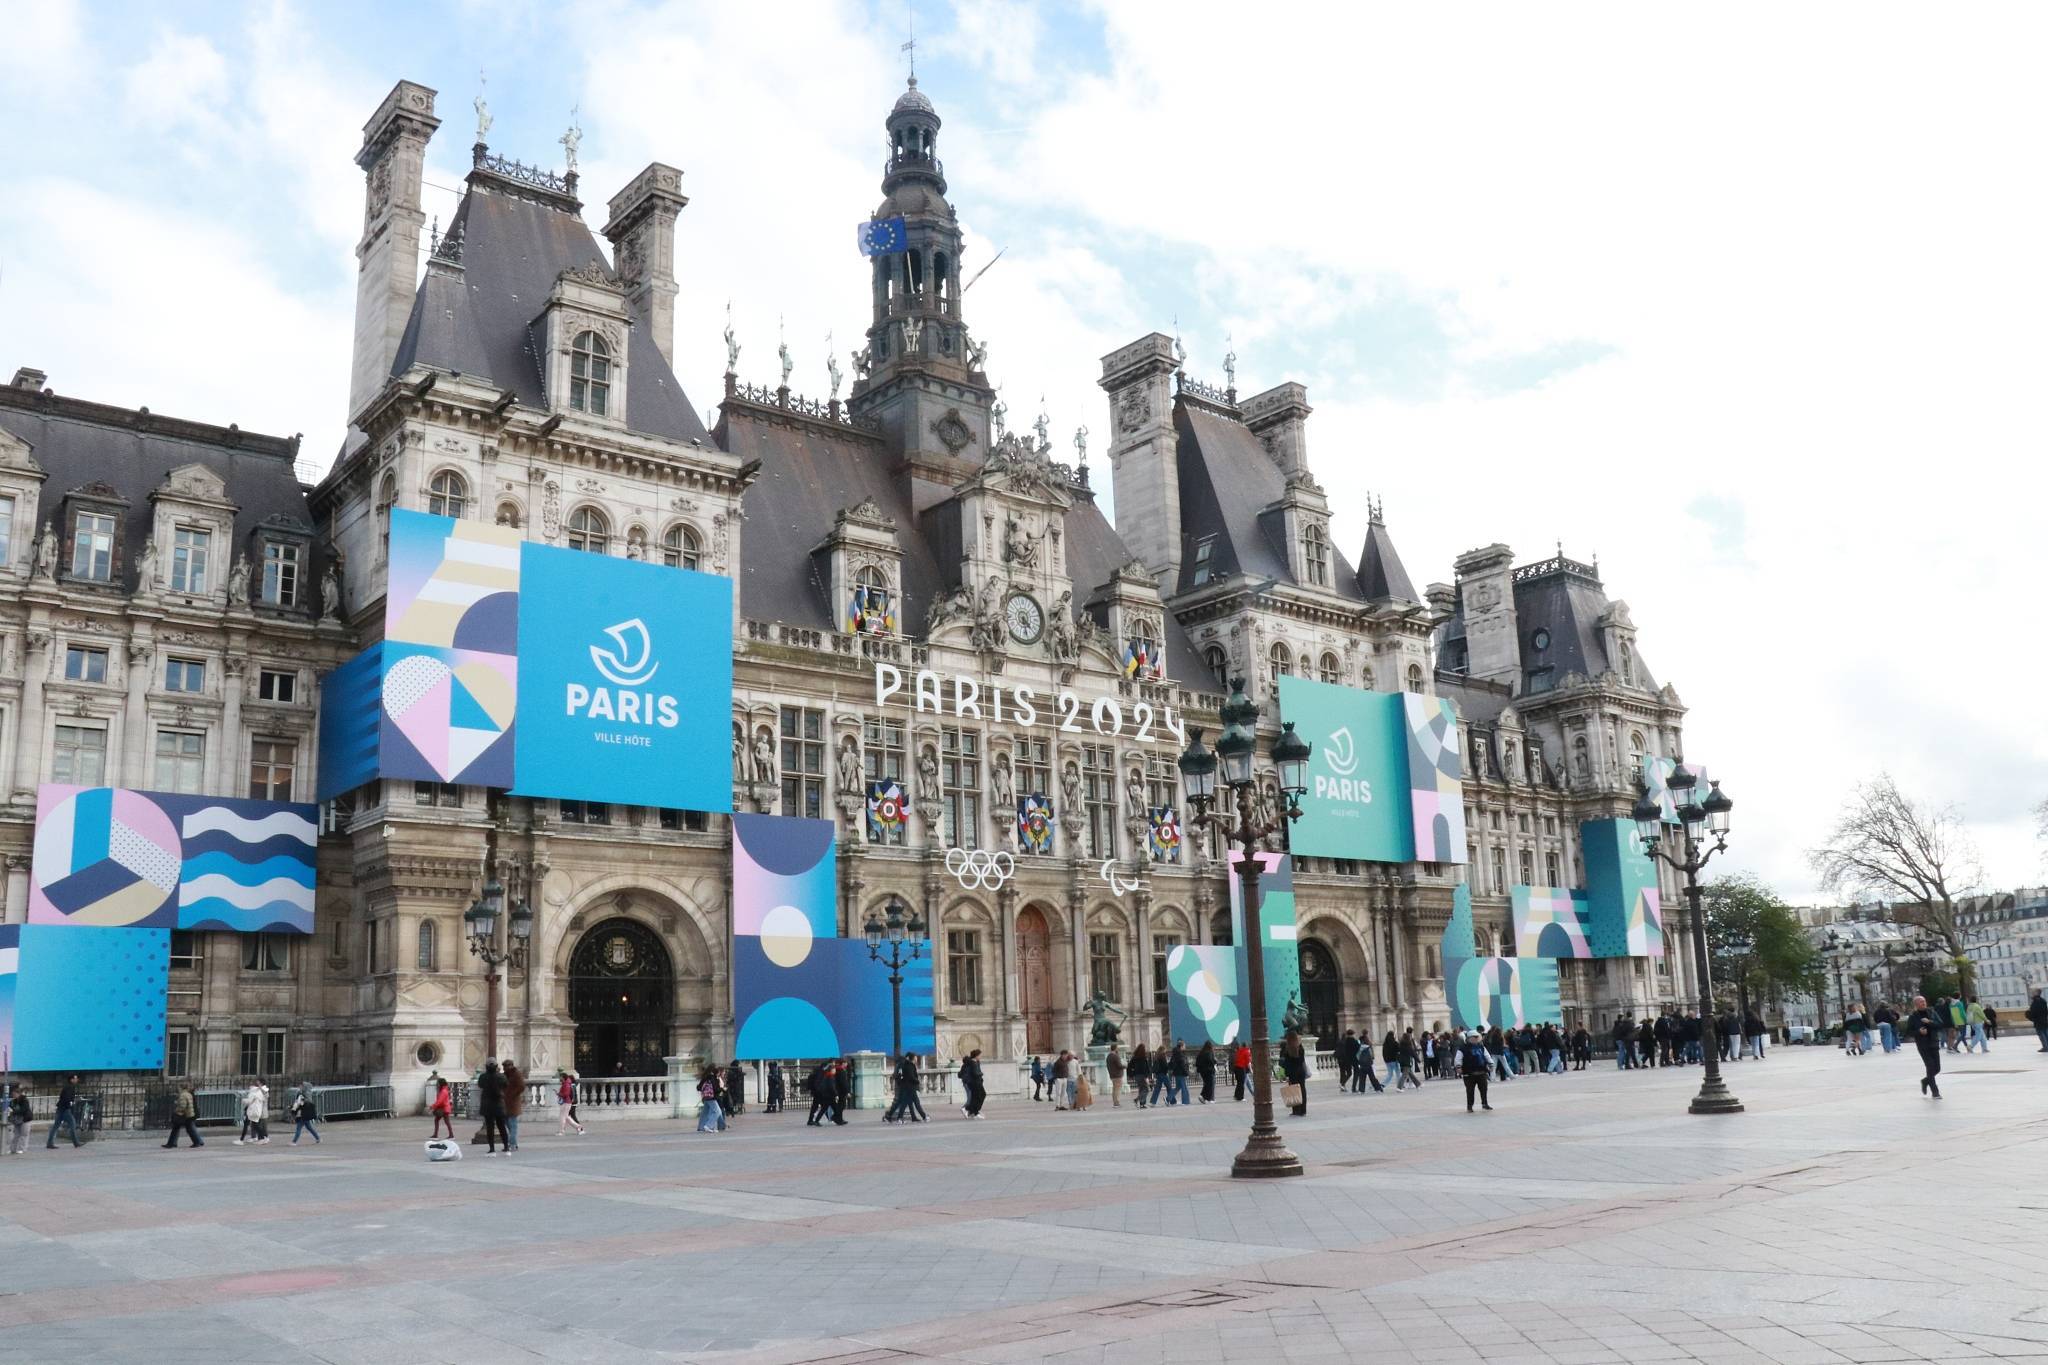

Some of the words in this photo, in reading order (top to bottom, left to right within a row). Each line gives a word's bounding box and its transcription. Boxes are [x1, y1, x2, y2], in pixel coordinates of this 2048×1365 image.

[566, 683, 679, 728] PARIS
[876, 663, 1036, 727] PARIS
[1058, 691, 1185, 747] 2024
[594, 732, 622, 744] VILLE
[624, 733, 652, 746] HÔTE
[1315, 775, 1372, 803] PARIS
